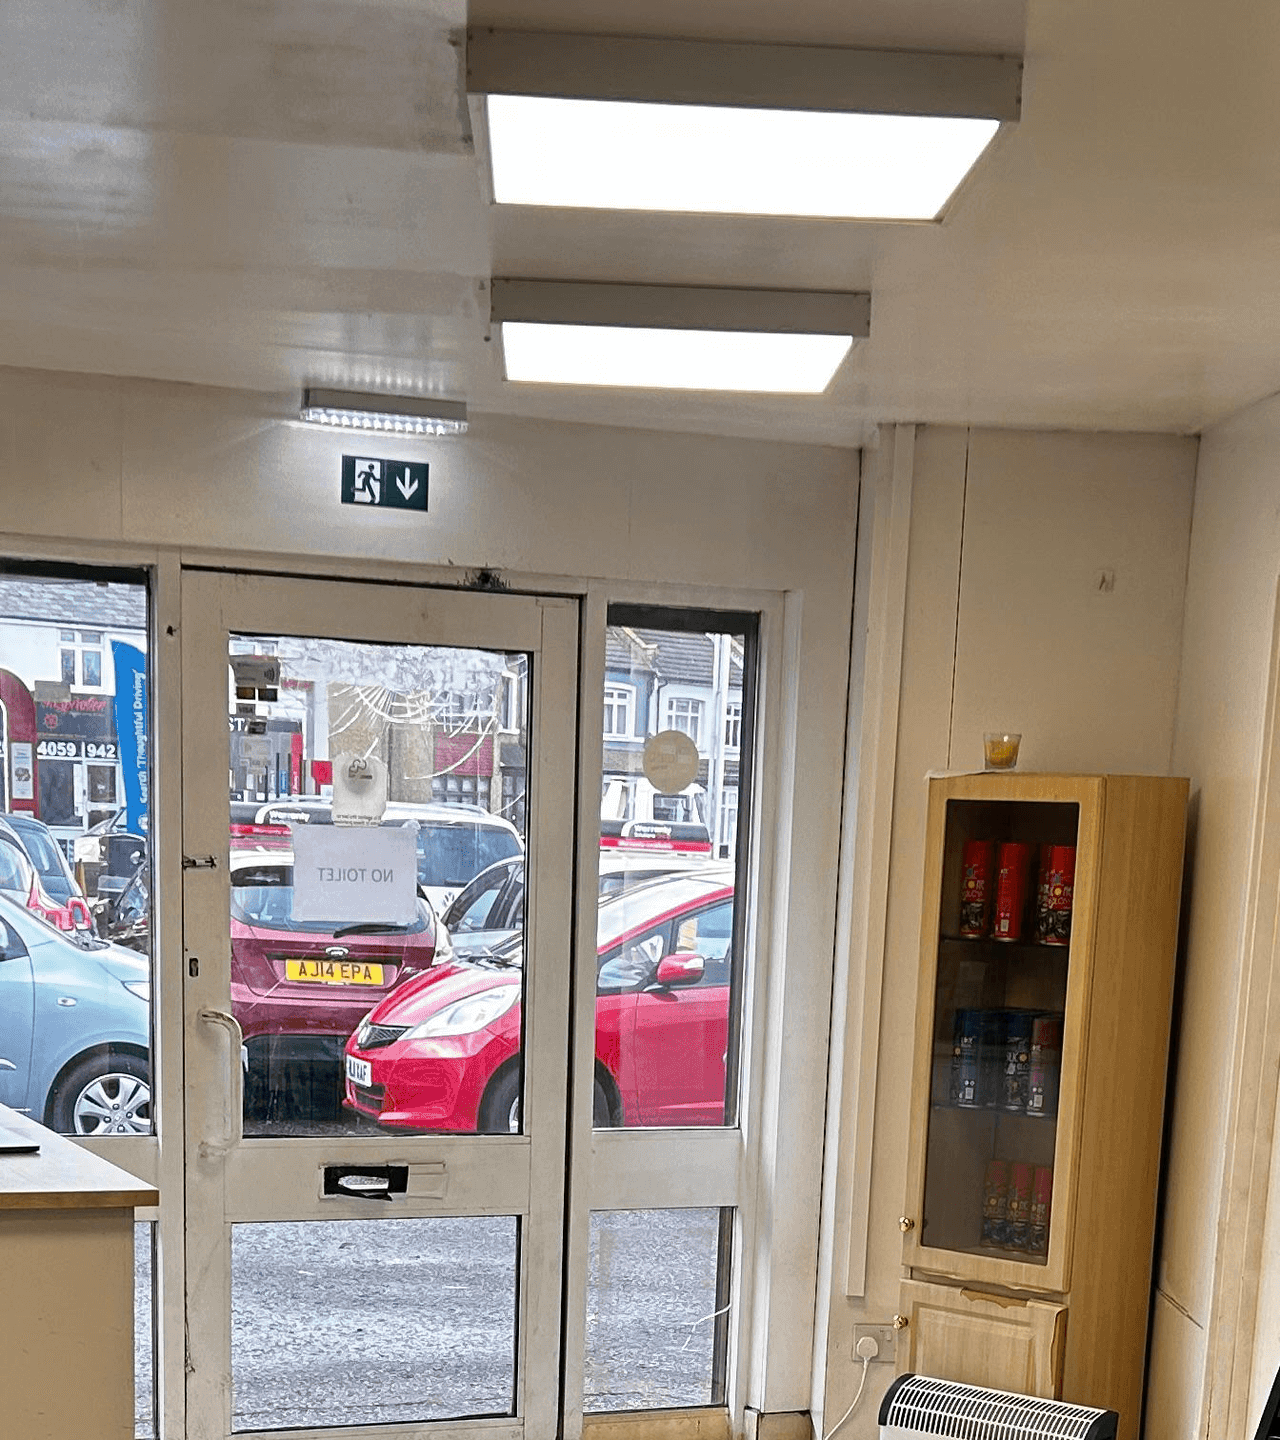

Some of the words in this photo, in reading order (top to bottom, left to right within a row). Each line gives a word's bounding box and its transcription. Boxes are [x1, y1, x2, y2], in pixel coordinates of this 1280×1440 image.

[37, 740, 77, 757] 4059
[86, 743, 116, 759] 942
[298, 961, 334, 978] AJ14
[340, 963, 372, 980] EPA
